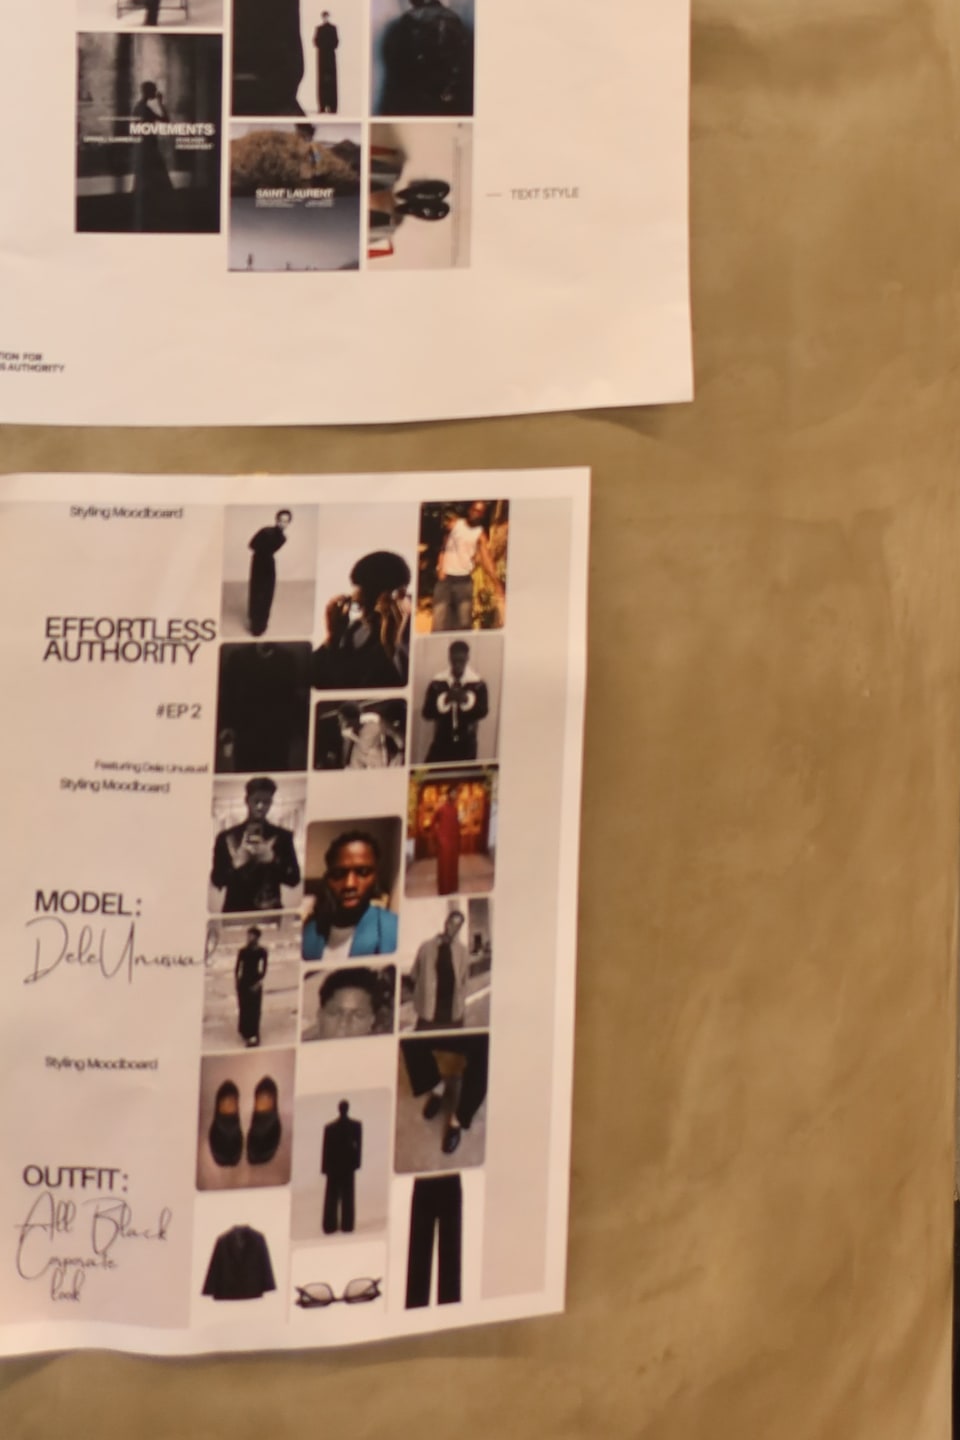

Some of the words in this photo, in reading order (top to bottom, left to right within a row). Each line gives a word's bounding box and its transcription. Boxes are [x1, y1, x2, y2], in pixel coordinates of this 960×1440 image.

[129, 122, 215, 136] MOVEMENTS
[256, 187, 285, 198] SAINT
[286, 187, 334, 198] LAURENT
[511, 188, 540, 201] TEXT
[542, 187, 579, 200] STYLE
[8, 363, 65, 373] AUTHORITY
[70, 505, 111, 520] Styling
[112, 506, 184, 518] Moodboard
[45, 616, 217, 641] EFFORTLESS
[43, 639, 201, 664] AUTHORITY
[60, 778, 101, 792] Styling
[102, 779, 171, 793] Moodboard
[34, 889, 142, 917] MODEL:
[45, 1056, 86, 1072] Styling
[87, 1058, 159, 1070] Moodboard
[22, 1164, 129, 1192] OUTFIT:
